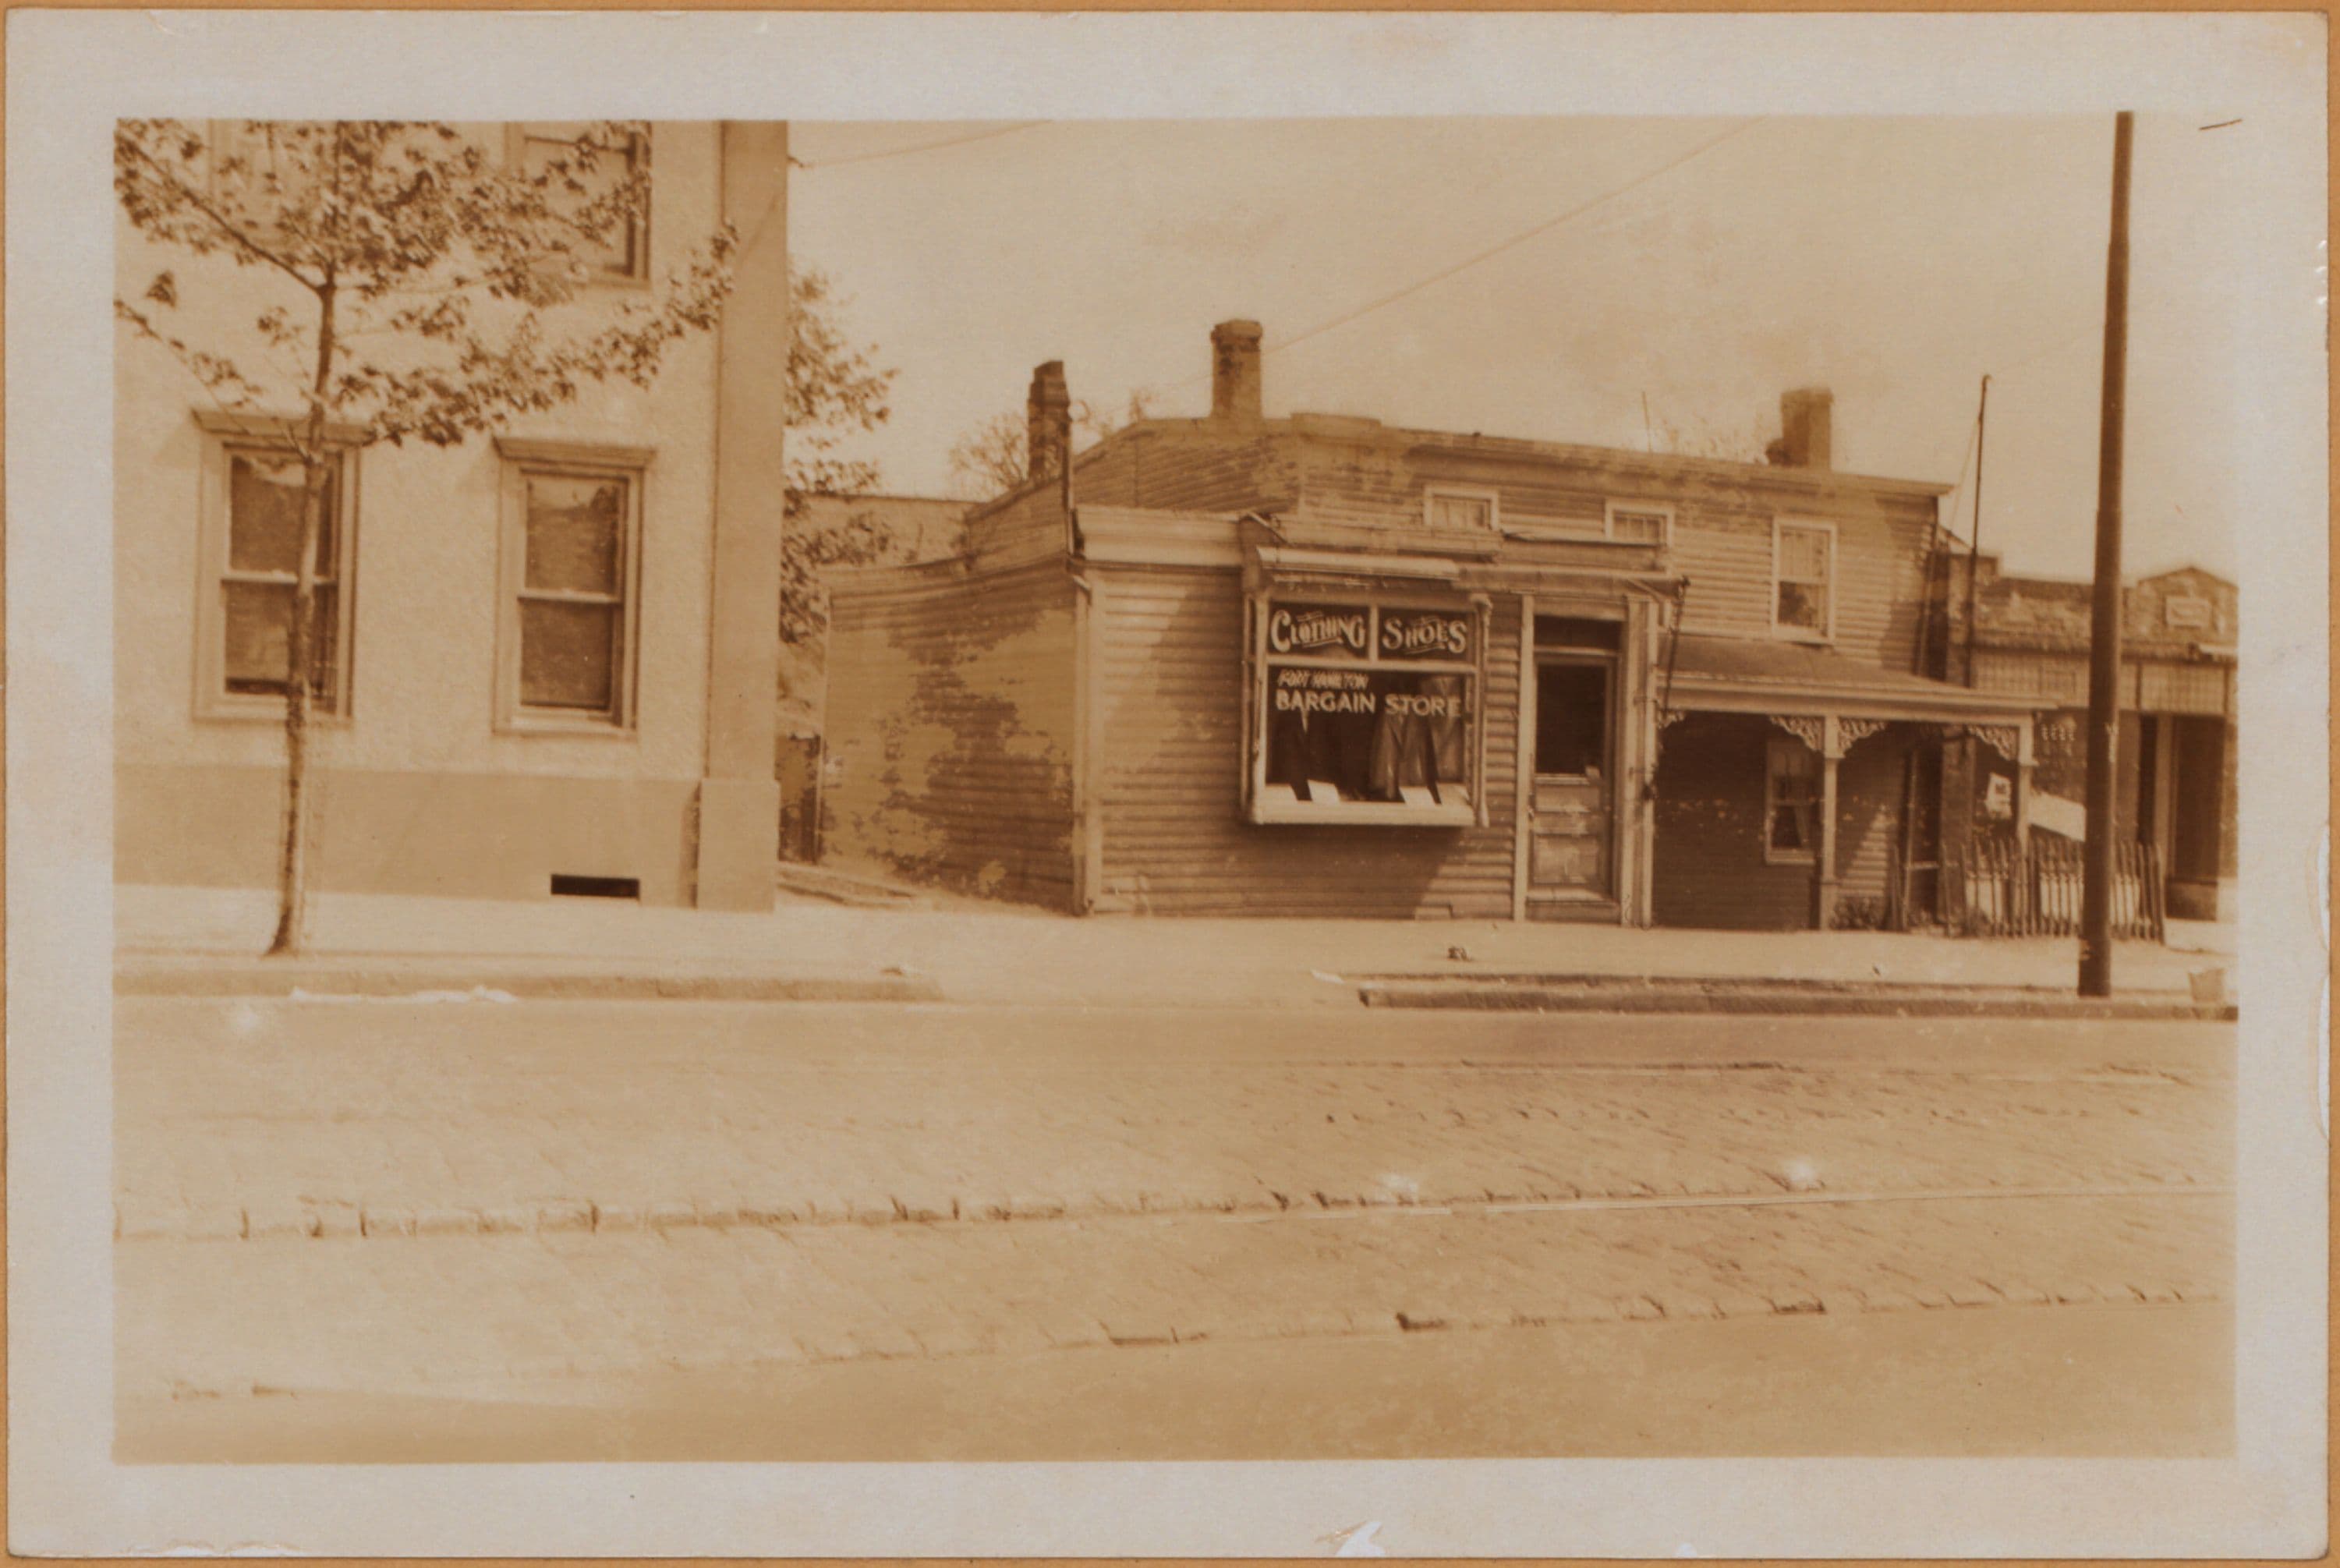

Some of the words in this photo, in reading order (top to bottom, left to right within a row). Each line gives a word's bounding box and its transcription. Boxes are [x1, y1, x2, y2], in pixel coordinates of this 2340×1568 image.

[1270, 609, 1365, 653] CLOTHING
[1382, 615, 1467, 653] SHOES
[1275, 688, 1375, 713] BARGAIN
[1385, 693, 1461, 717] STORE
